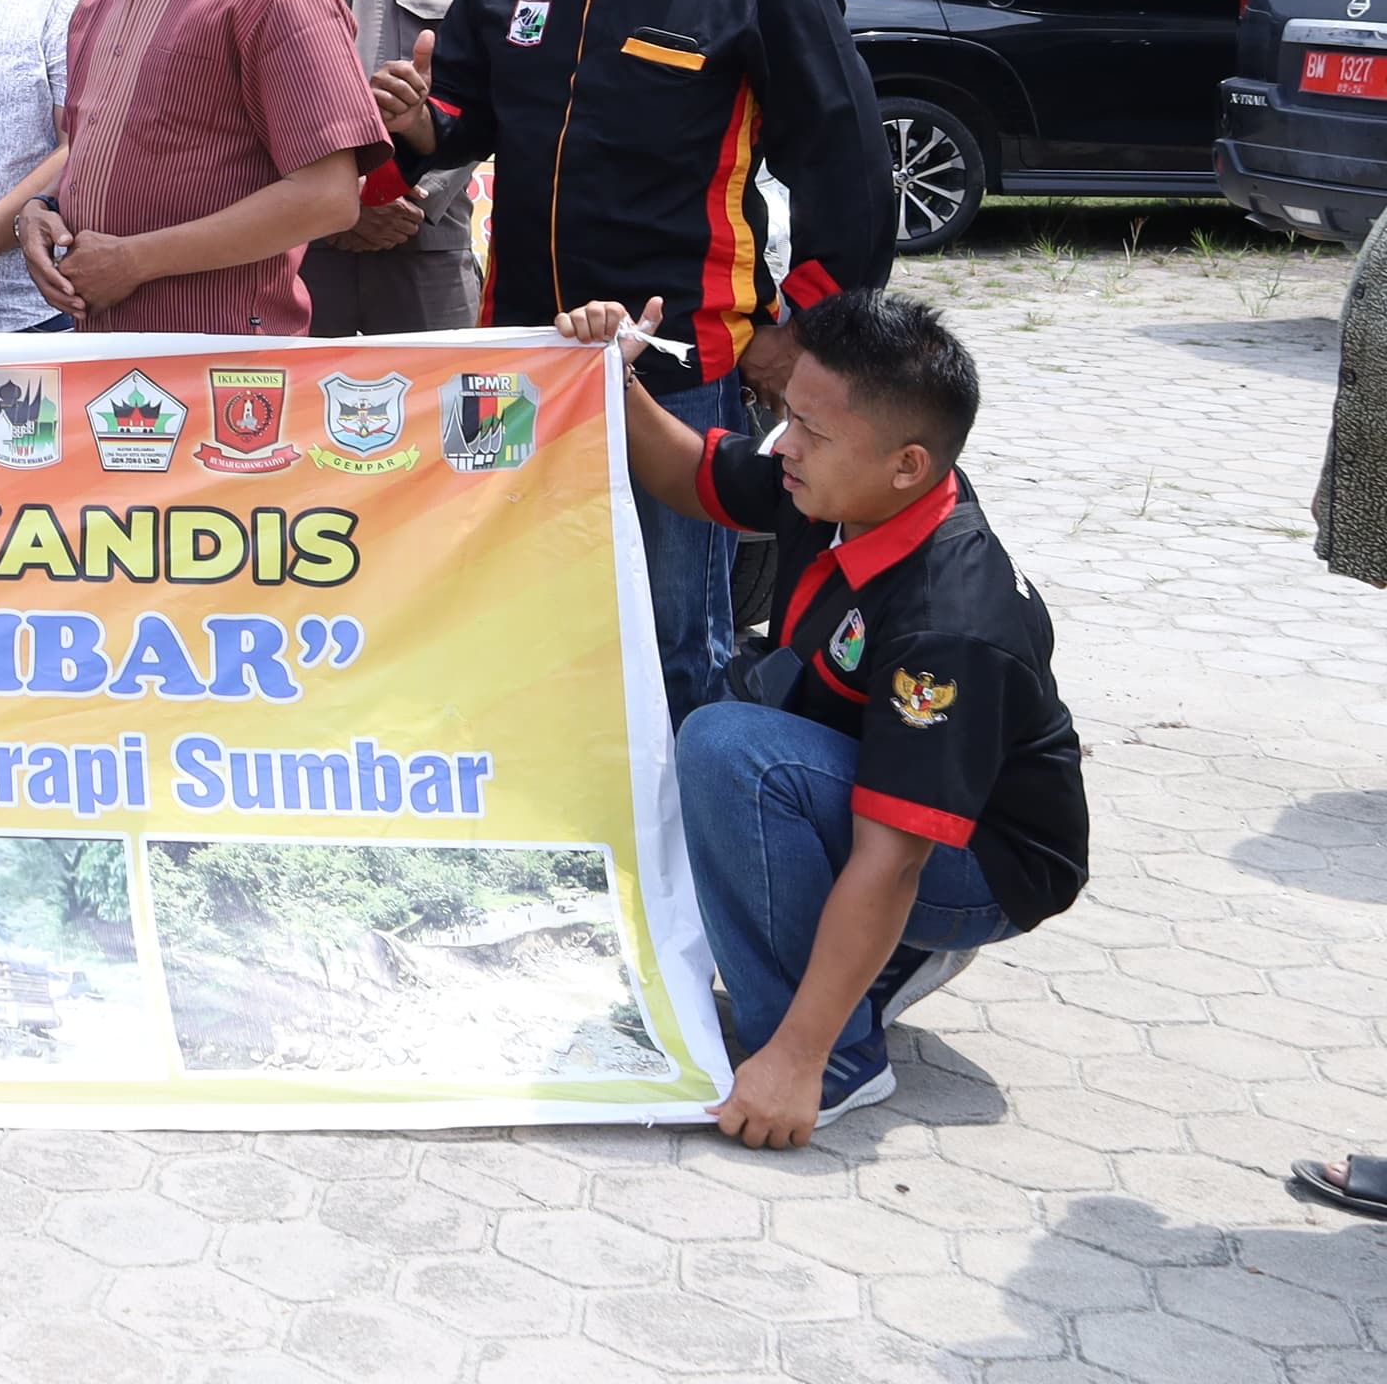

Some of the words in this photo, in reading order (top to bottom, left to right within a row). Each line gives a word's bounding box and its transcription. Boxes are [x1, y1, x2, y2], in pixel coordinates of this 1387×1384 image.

[1306, 52, 1327, 79] BM
[1339, 55, 1374, 82] 1327
[1229, 92, 1268, 107] X-TRAIL
[218, 375, 242, 384] IKLA
[243, 376, 279, 384] KANDIS
[468, 376, 511, 391] IPMR
[144, 457, 161, 465] LIMO
[333, 457, 396, 472] GEMPAR
[175, 736, 489, 814] Sumbar
